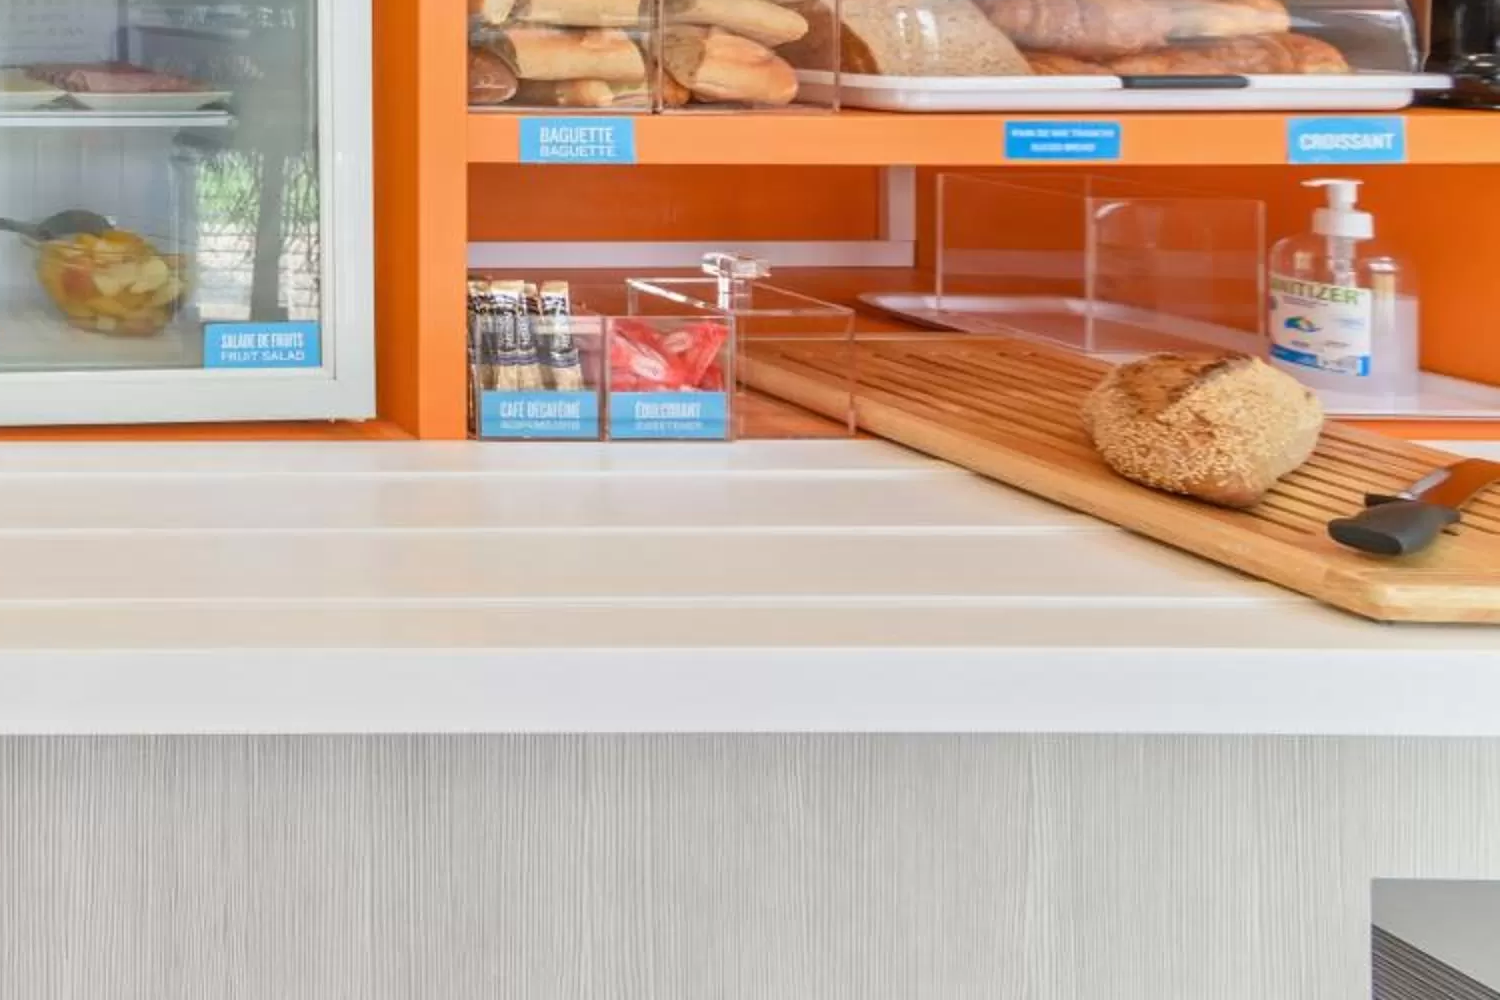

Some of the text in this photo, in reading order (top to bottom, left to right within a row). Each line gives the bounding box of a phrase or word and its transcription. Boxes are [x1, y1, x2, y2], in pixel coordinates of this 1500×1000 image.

[540, 127, 613, 143] BAGUETTE
[1299, 132, 1396, 151] CROISSANT
[540, 145, 618, 157] BAGUETTE
[261, 349, 305, 361] SALAD
